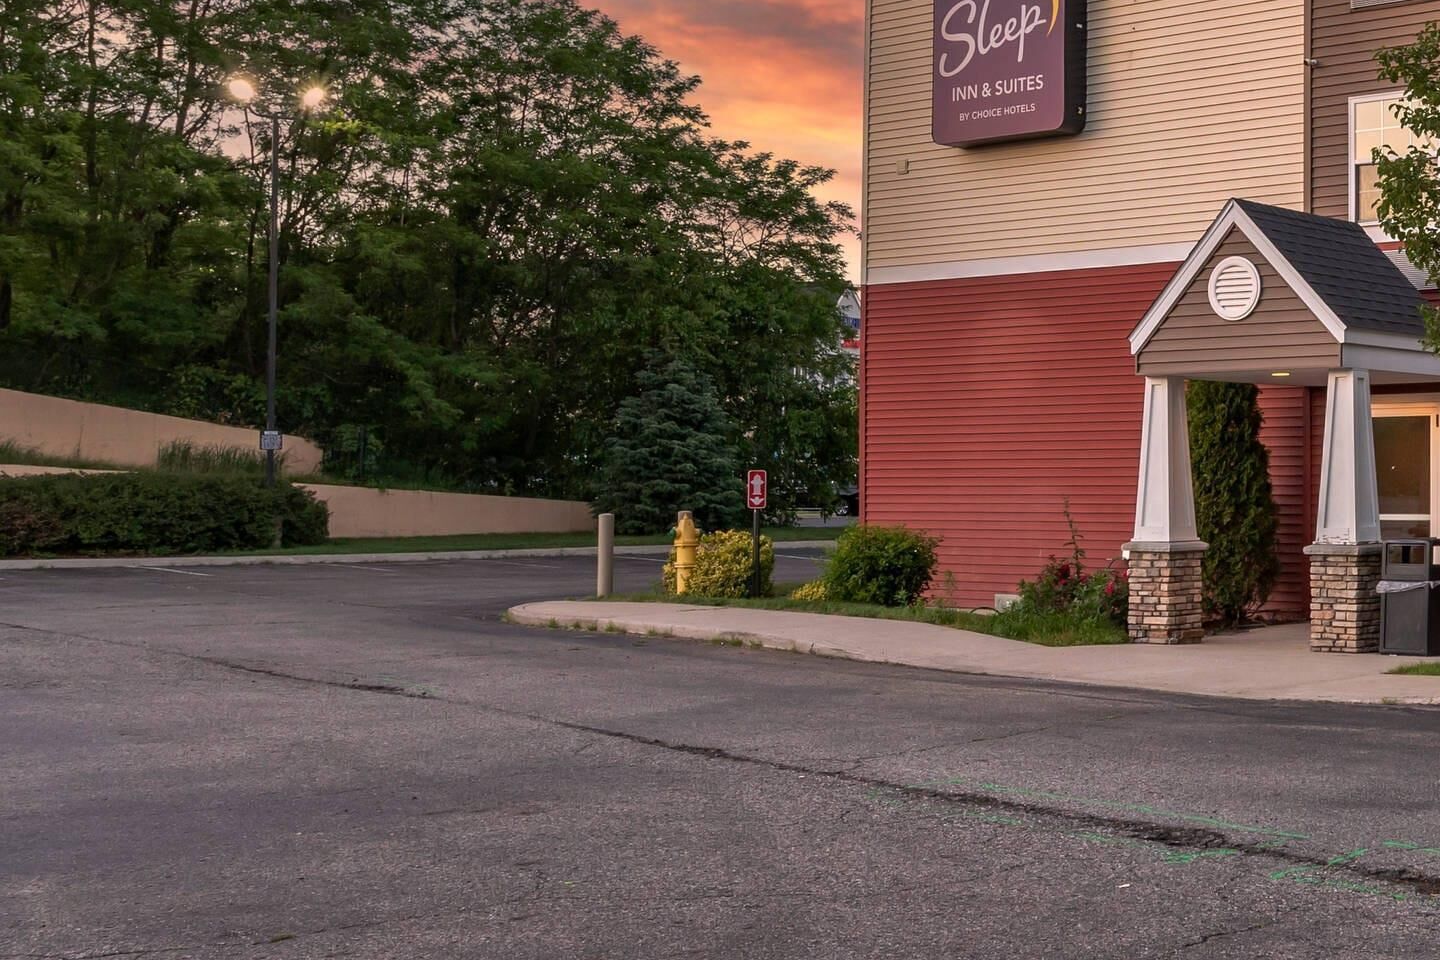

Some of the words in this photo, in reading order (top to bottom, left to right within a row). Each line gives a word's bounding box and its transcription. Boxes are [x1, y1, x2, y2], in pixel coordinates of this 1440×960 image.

[952, 84, 978, 102] INN
[981, 82, 992, 98] &
[994, 74, 1044, 96] SUITES
[959, 112, 970, 122] BY
[971, 107, 1002, 120] CHOICE
[1003, 103, 1036, 115] HOTELS
